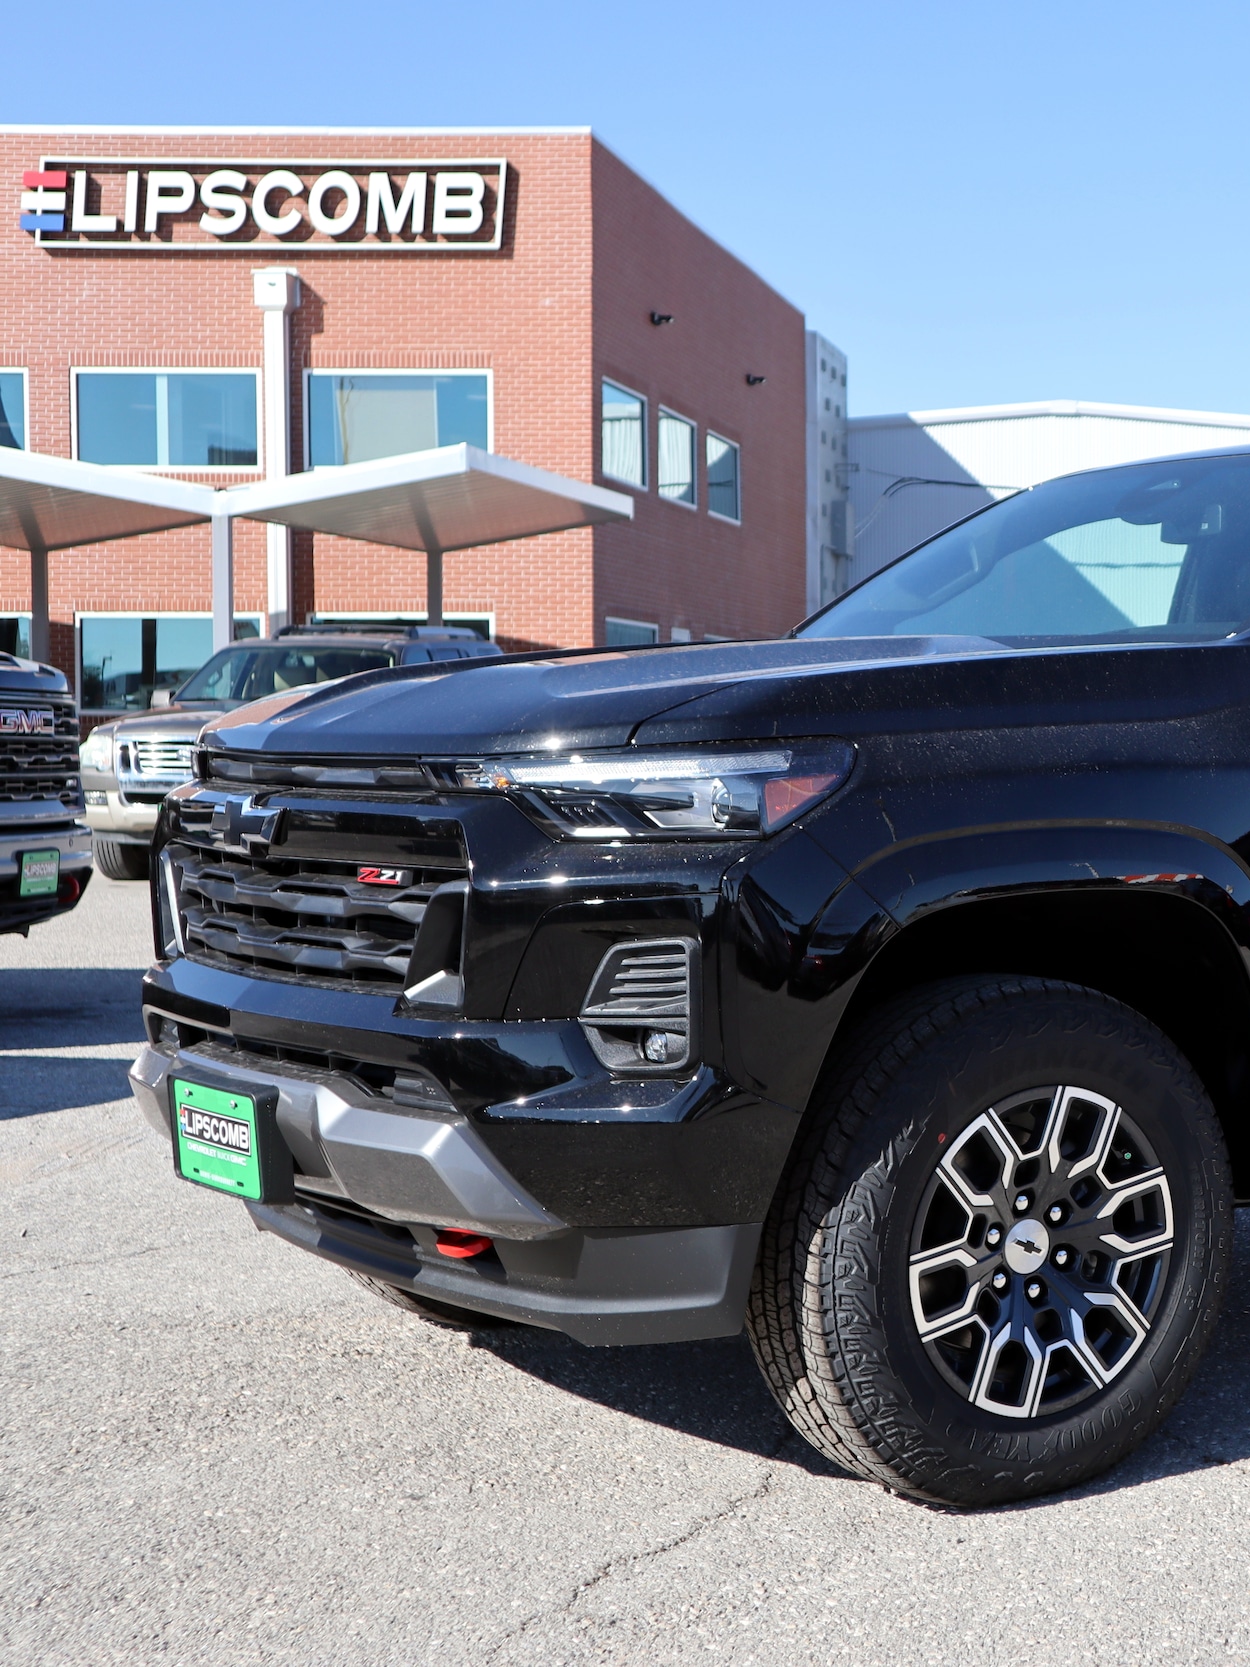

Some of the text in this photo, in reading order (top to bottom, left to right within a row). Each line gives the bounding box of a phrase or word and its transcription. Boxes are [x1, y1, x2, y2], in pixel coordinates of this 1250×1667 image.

[71, 169, 487, 236] LIPSCOMB
[0, 709, 54, 734] GMC
[357, 867, 401, 885] Z71
[184, 1109, 250, 1149] LIPSCOMB
